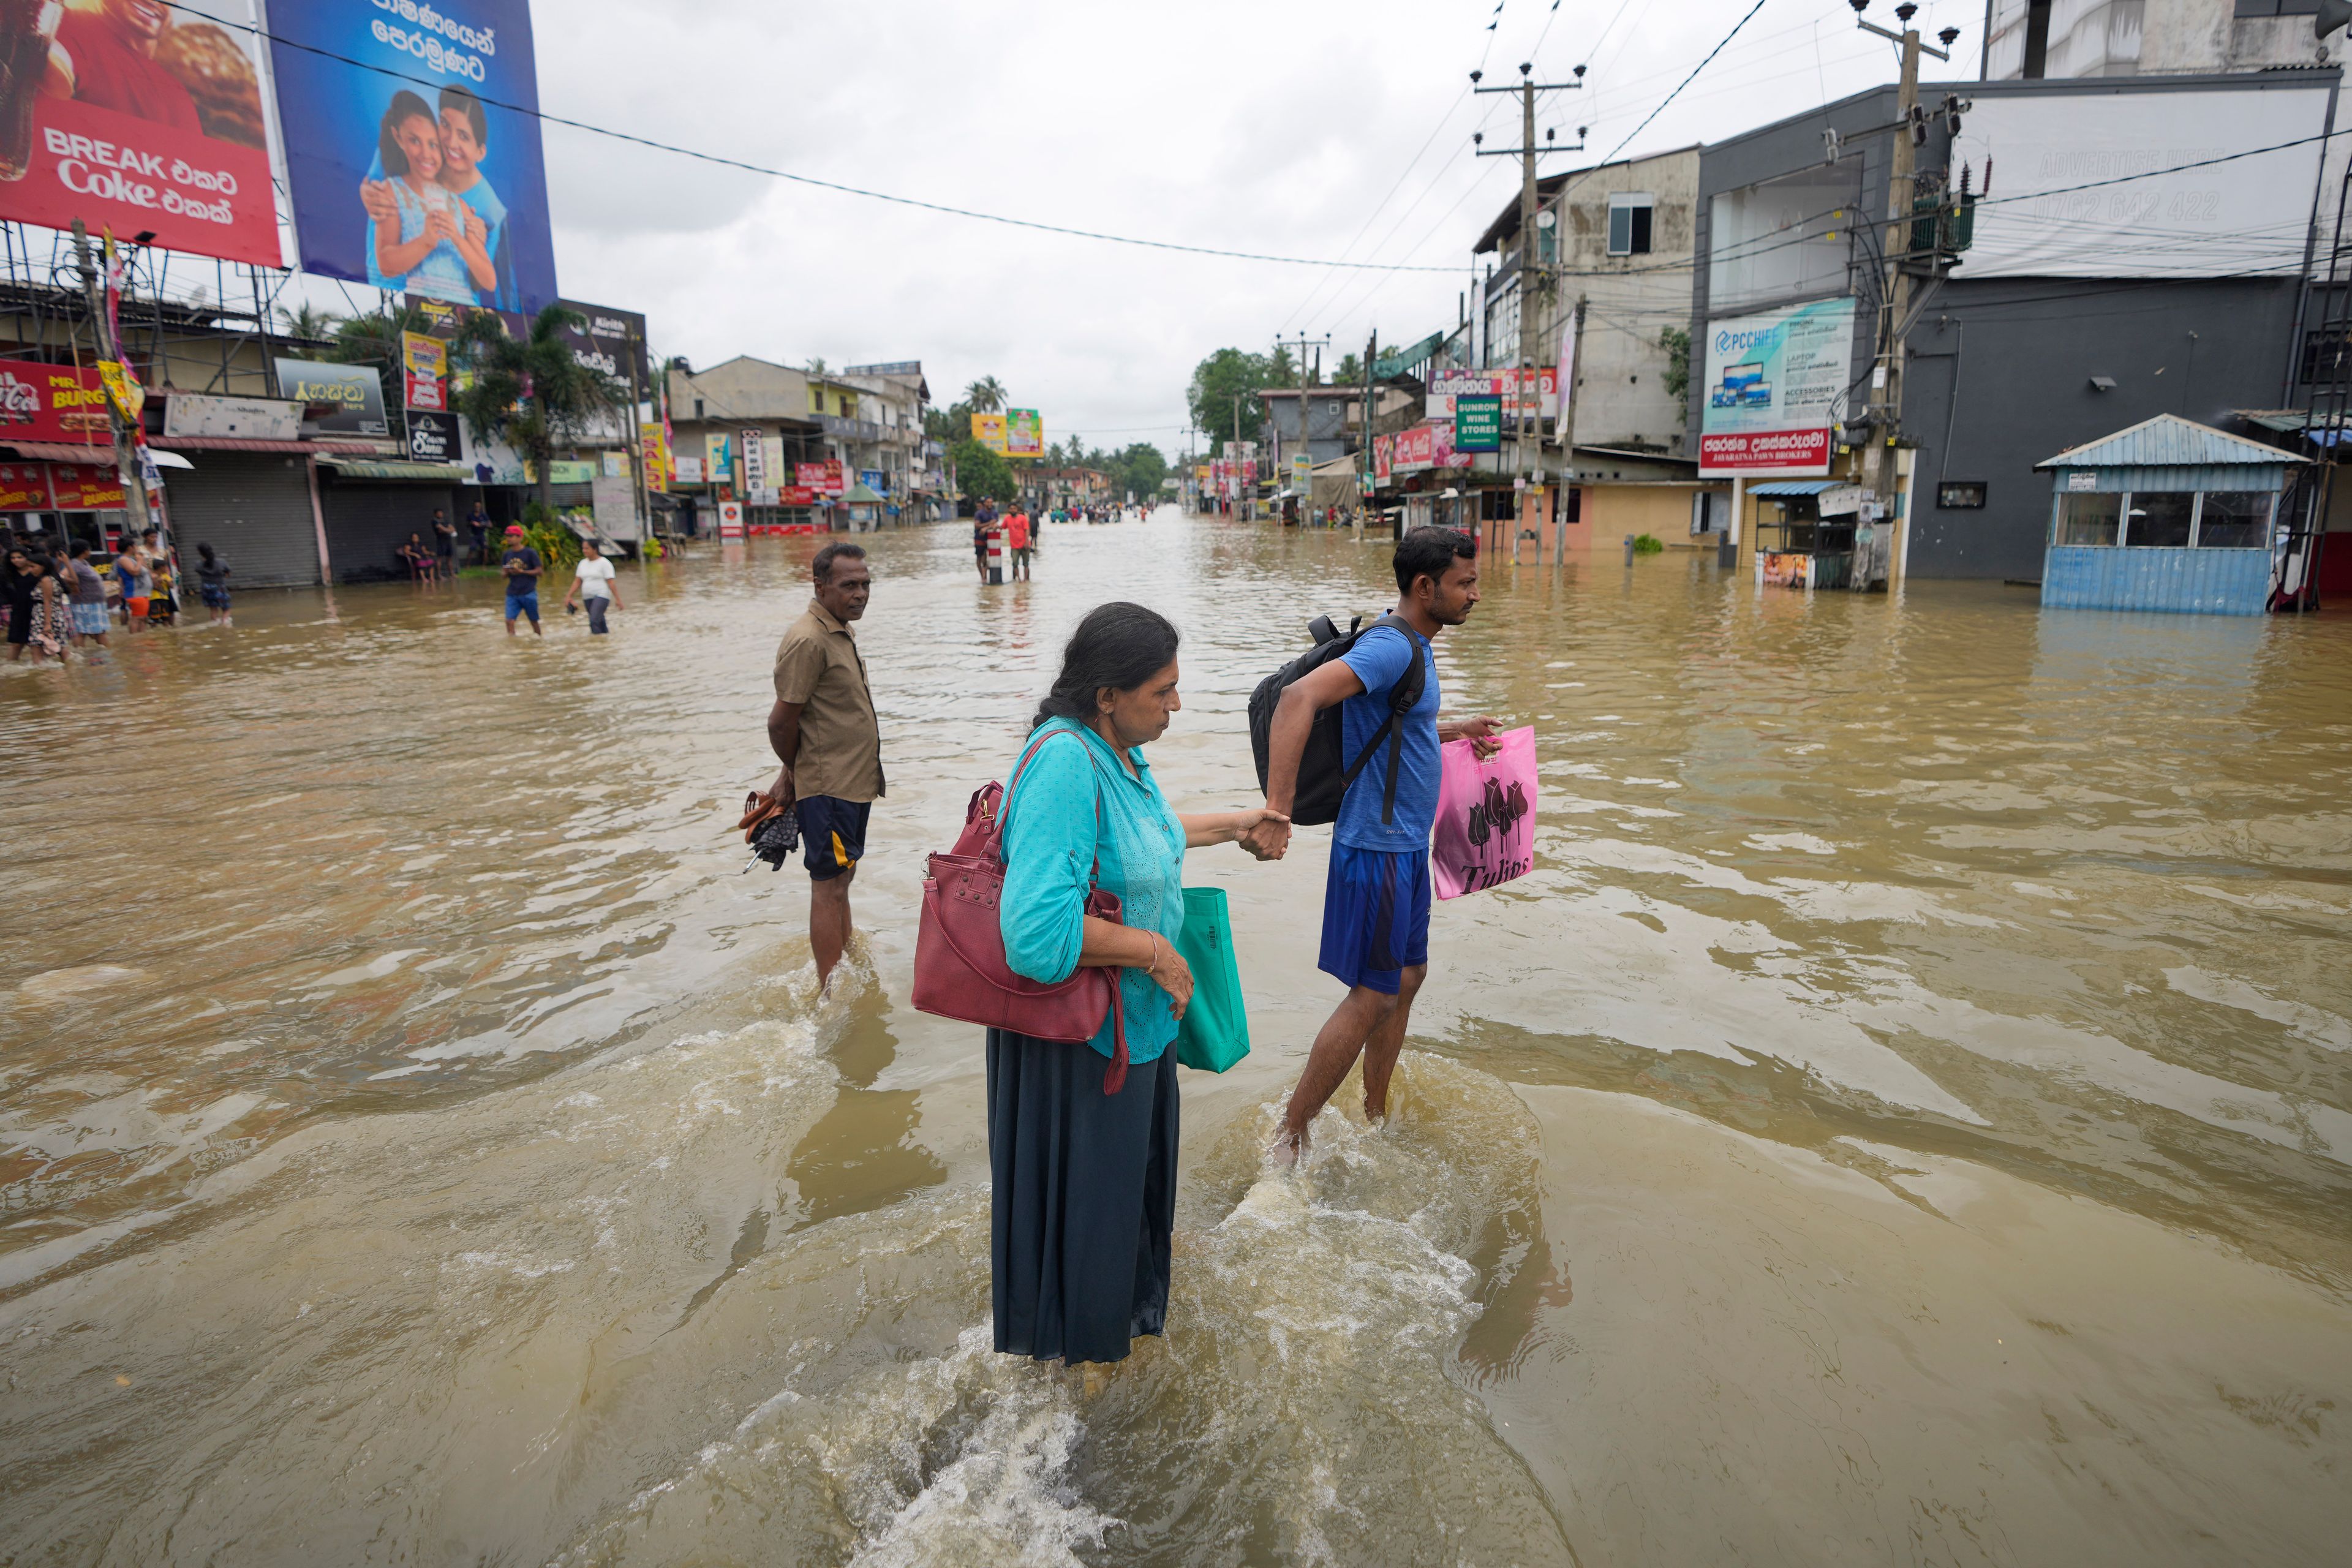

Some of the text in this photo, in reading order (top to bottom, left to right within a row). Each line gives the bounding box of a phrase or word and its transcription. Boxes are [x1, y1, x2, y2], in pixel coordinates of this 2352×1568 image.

[43, 127, 238, 195] BREAK එකට
[2038, 148, 2225, 178] ADVERTISE HERE
[58, 159, 233, 225] Coke එකක්
[2034, 190, 2220, 224] 0762 642 422
[1787, 353, 1815, 363] LAPTOP
[1785, 385, 1835, 395] ACCESSORIES
[53, 389, 107, 409] BURG
[1458, 402, 1499, 413] SUNROW
[1466, 414, 1491, 423] WINE
[1461, 425, 1498, 434] STORES
[1713, 450, 1812, 462] JAYARATNA PAWN BROKERS
[1460, 857, 1529, 894] Tulips
